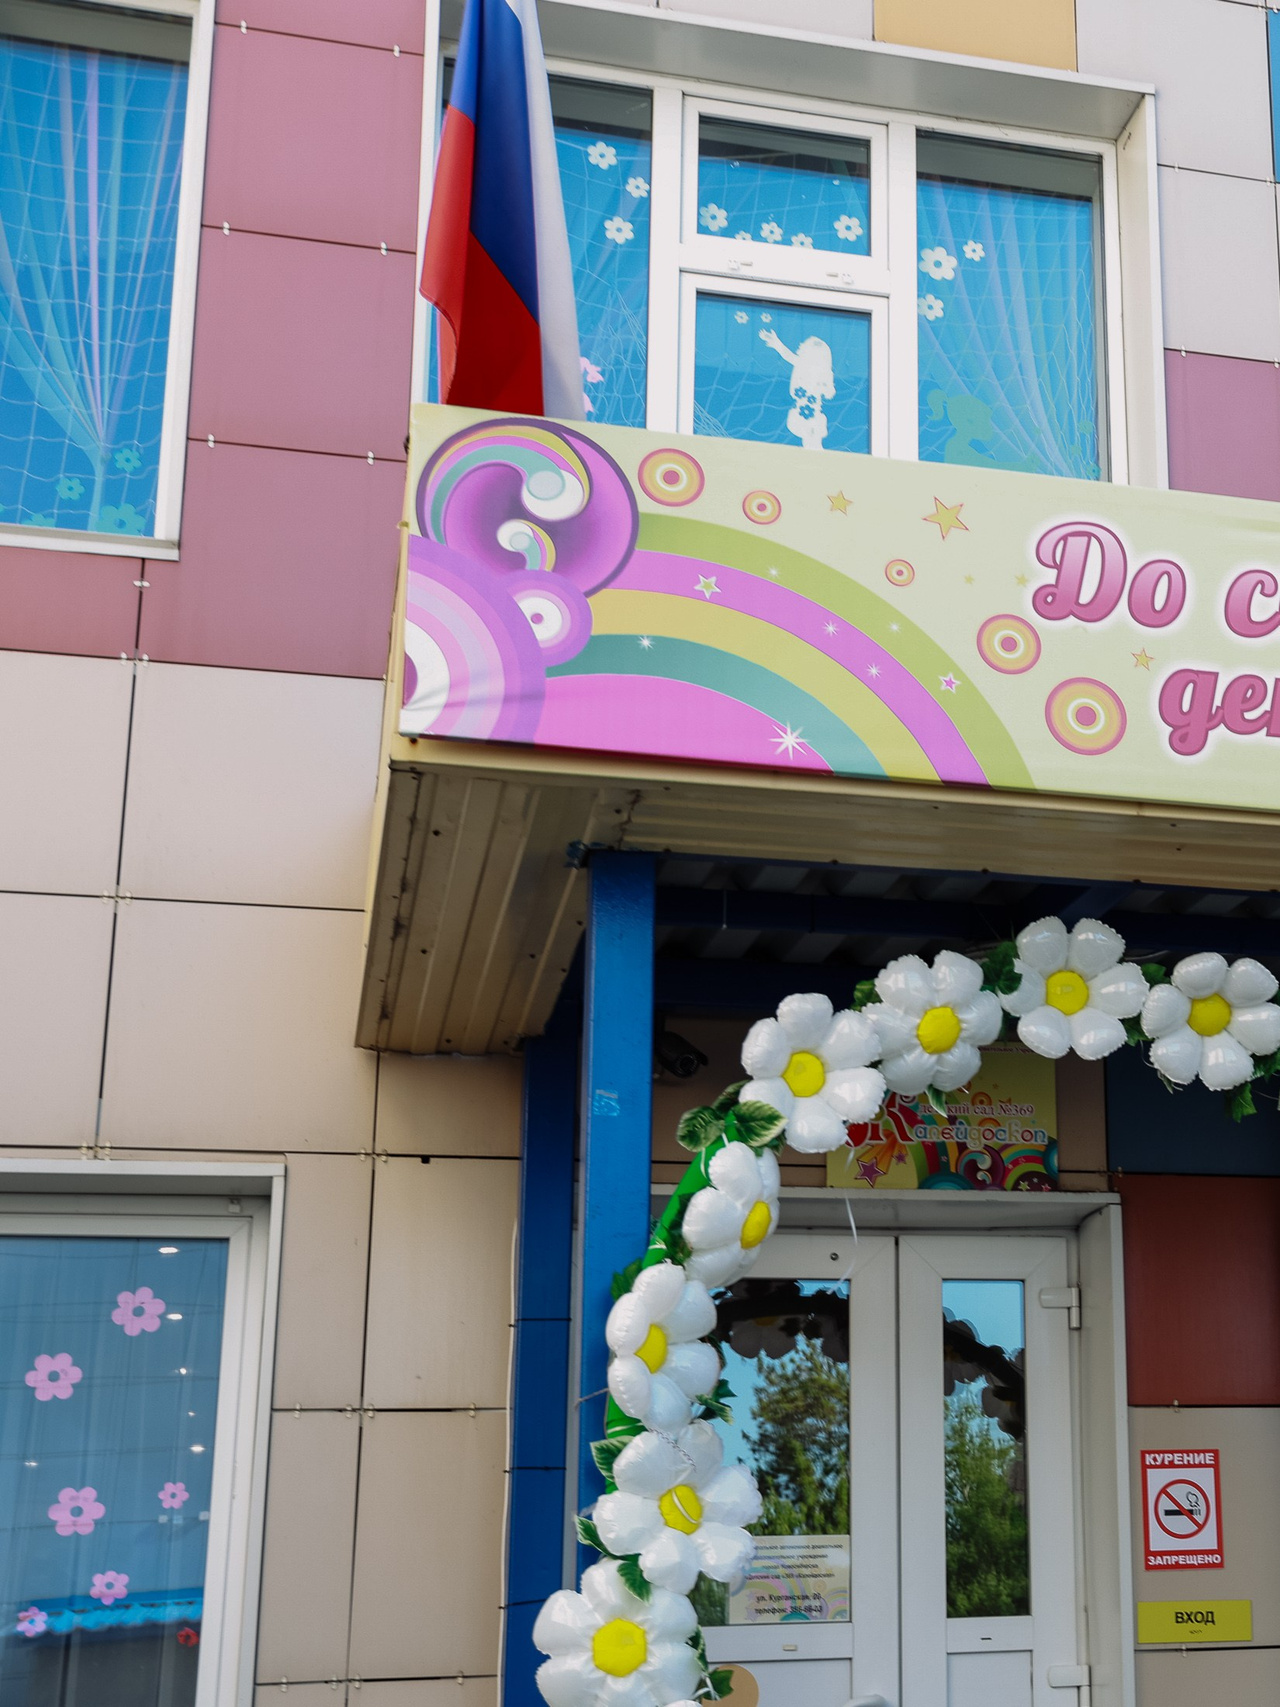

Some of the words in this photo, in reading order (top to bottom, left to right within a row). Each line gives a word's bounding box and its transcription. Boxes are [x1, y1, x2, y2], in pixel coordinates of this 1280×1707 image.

[1032, 521, 1187, 628] До
[919, 1102, 970, 1116] декий
[973, 1104, 995, 1116] сад
[998, 1103, 1035, 1118] №369
[1145, 1452, 1215, 1465] КУРЕНИЕ
[1147, 1553, 1222, 1566] ЗАПРЕЩЕНО
[1174, 1611, 1216, 1626] ВХОД
